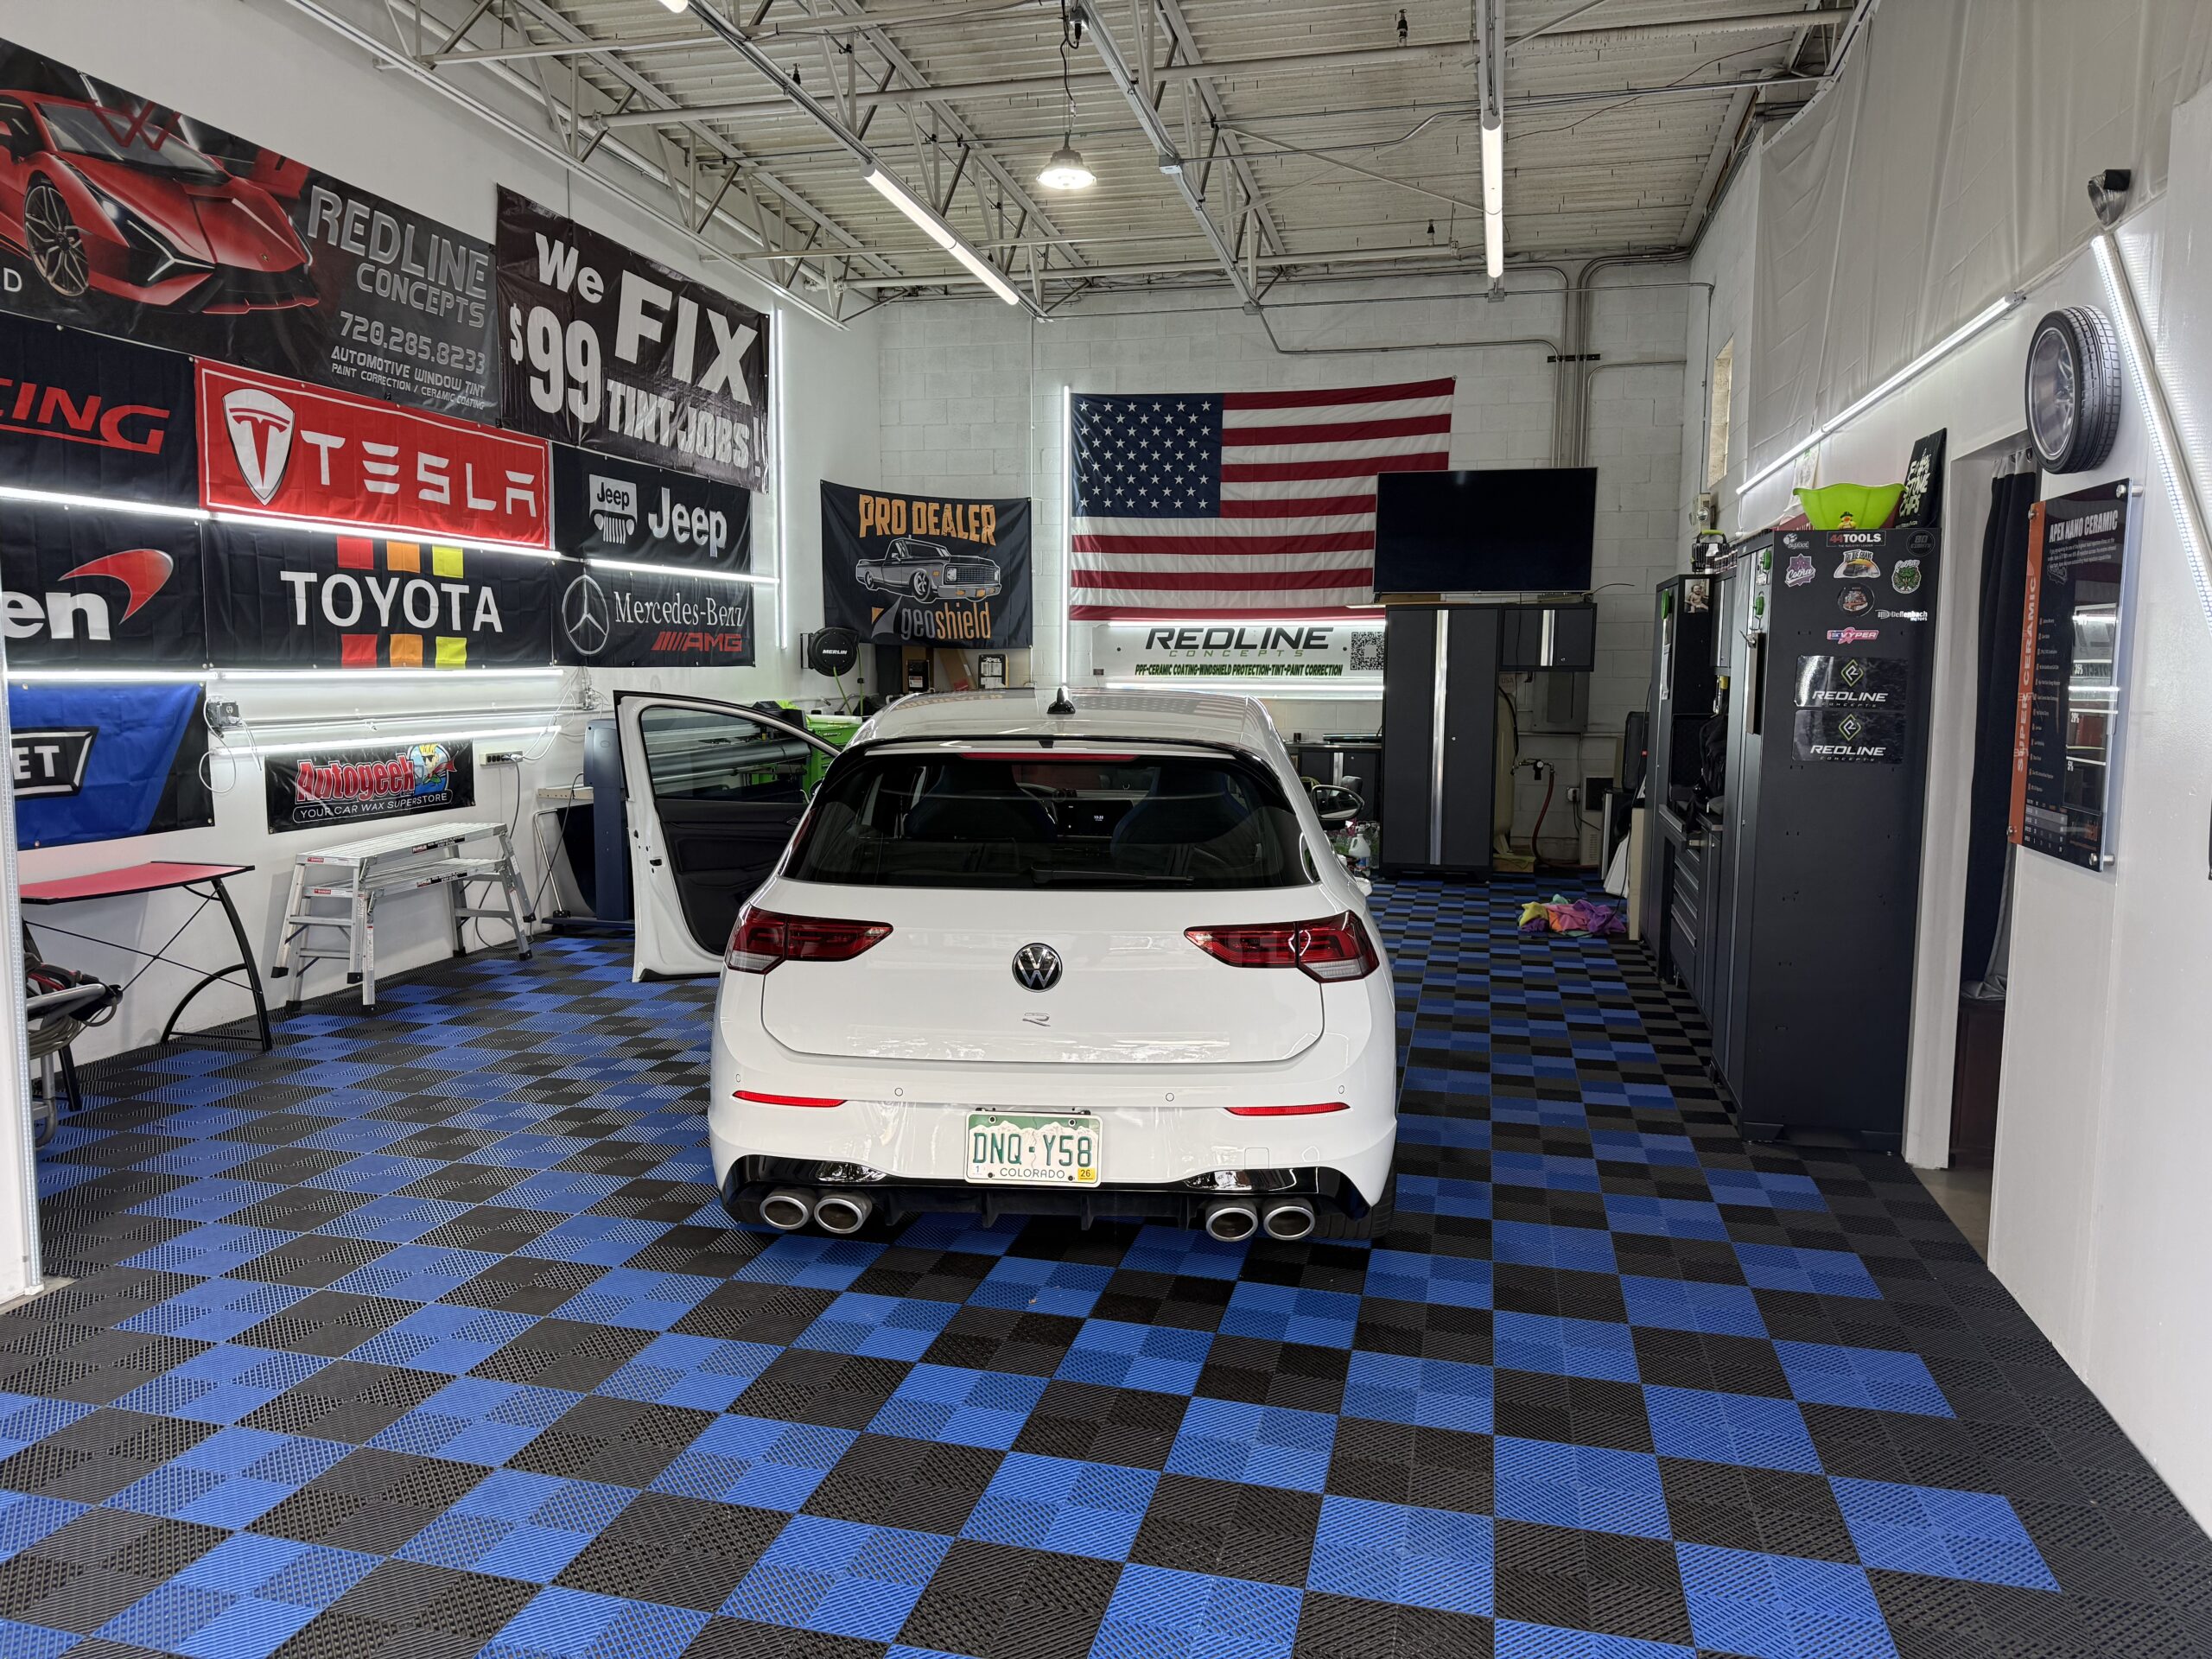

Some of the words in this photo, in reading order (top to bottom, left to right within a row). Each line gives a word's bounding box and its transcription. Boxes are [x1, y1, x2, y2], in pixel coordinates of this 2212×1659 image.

[308, 185, 489, 300] REDLINE
[356, 263, 486, 328] CONCEPTS
[535, 232, 604, 303] We
[614, 270, 759, 406] FIX
[340, 310, 486, 375] 720.285.8233
[509, 302, 602, 423] $99
[331, 346, 410, 378] AUTOMOTIVE
[414, 367, 462, 391] WINDOW
[465, 380, 486, 397] TINT
[332, 363, 357, 378] PAINT
[360, 370, 411, 392] CORRECTION
[421, 386, 455, 403] CERAMIC
[456, 395, 485, 410] COATING
[0, 378, 170, 454] ING
[607, 378, 675, 448] TINT
[301, 429, 537, 518] TESLA
[597, 481, 630, 511] Jeep
[648, 486, 728, 558] Jeep
[859, 493, 906, 538] PRO
[912, 500, 996, 546] DEALER
[2049, 521, 2065, 543] APEX
[2084, 509, 2119, 536] CERAMIC
[280, 570, 503, 632] TOYOTA
[613, 591, 744, 627] Mercedes-Benz
[900, 601, 991, 641] geoshield
[1145, 626, 1334, 650] REDLINE
[2023, 577, 2037, 686] CERAMIC
[1305, 664, 1344, 677] CORRECTION
[1812, 690, 1889, 702] REDLINE
[1810, 745, 1886, 756] REDLINE
[296, 753, 416, 804] Autogeek
[300, 807, 332, 819] YOUR
[334, 804, 358, 815] CAR
[361, 802, 385, 812] WAX
[387, 792, 448, 809] SUPERSTORE
[1000, 1167, 1065, 1179] COLORADO
[1080, 1169, 1091, 1178] 26
